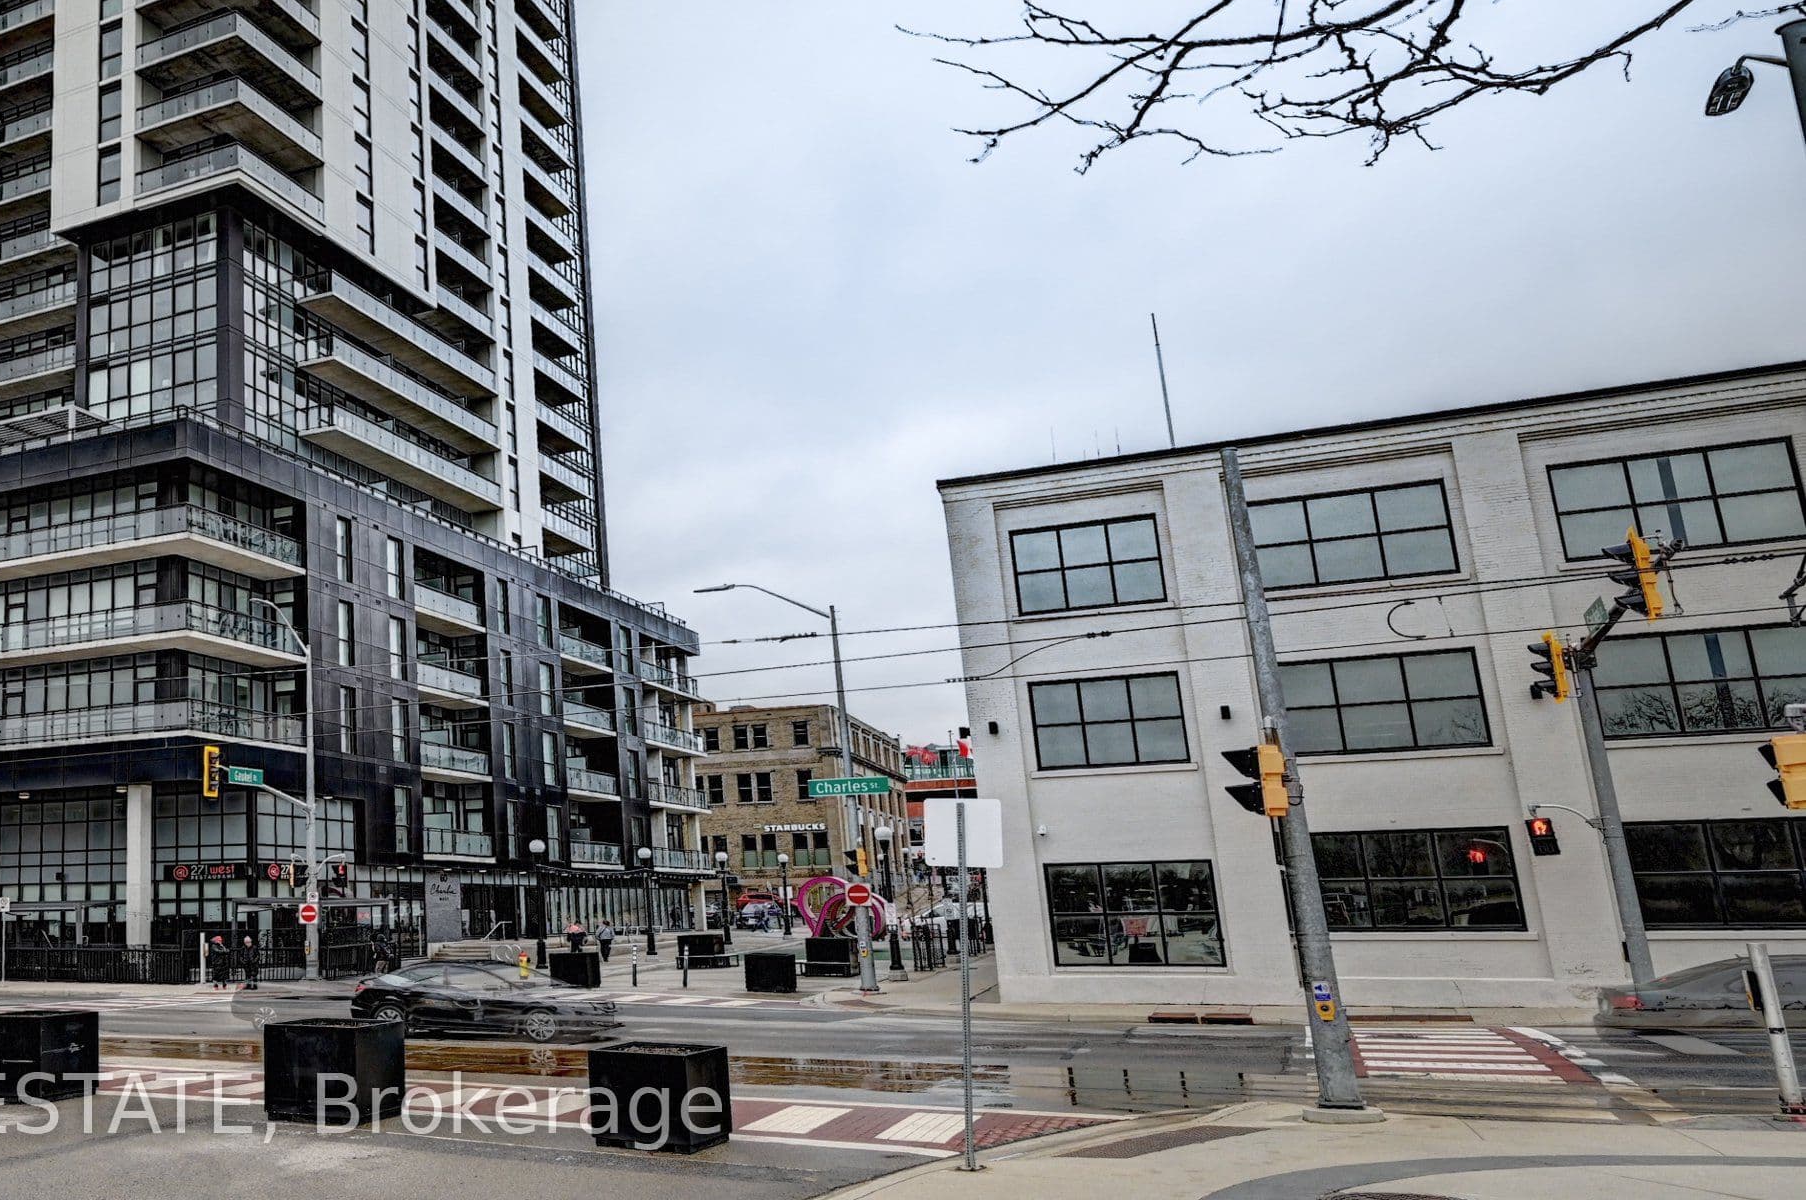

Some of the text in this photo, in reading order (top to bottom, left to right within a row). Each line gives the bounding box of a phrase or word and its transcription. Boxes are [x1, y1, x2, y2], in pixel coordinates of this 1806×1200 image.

[815, 781, 868, 794] Charles
[764, 823, 826, 832] STARBUCKS
[209, 864, 235, 875] west
